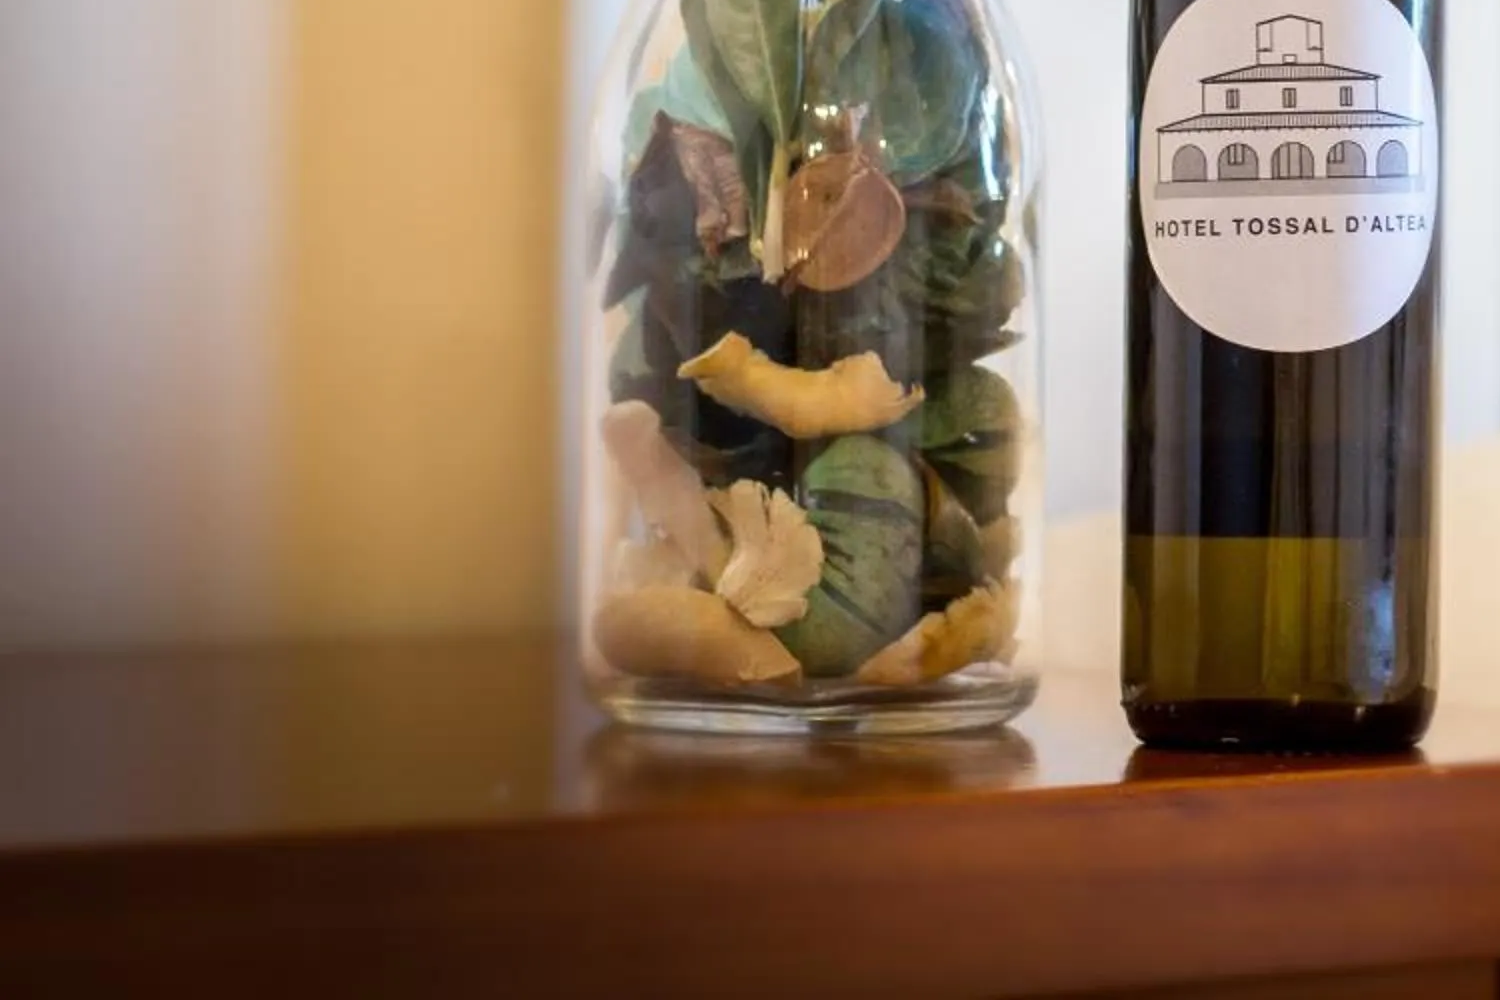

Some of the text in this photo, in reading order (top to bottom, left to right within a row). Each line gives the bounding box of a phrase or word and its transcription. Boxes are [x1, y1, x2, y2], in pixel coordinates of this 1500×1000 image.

[1154, 215, 1427, 238] HOTEL TOSSAL D'ALTEA
